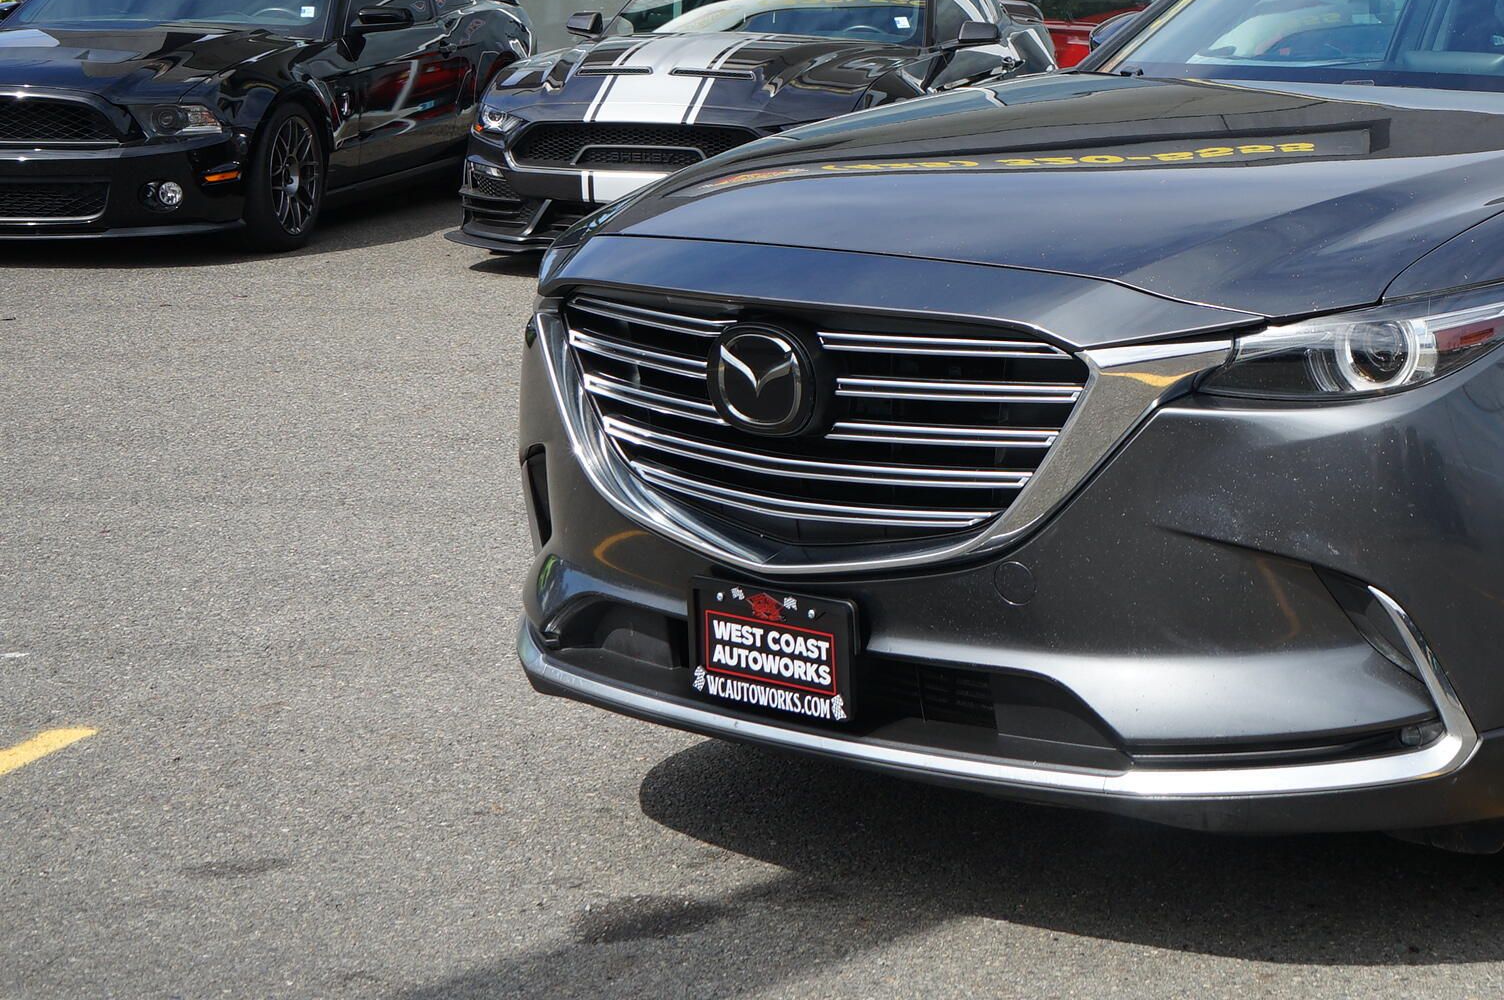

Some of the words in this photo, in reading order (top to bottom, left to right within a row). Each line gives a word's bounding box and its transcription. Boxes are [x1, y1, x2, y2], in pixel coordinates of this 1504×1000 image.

[712, 619, 764, 647] WEST
[767, 630, 830, 661] COAST
[712, 644, 832, 686] AUTOWORKS
[706, 675, 831, 719] WCAUTOWORKS.COM
